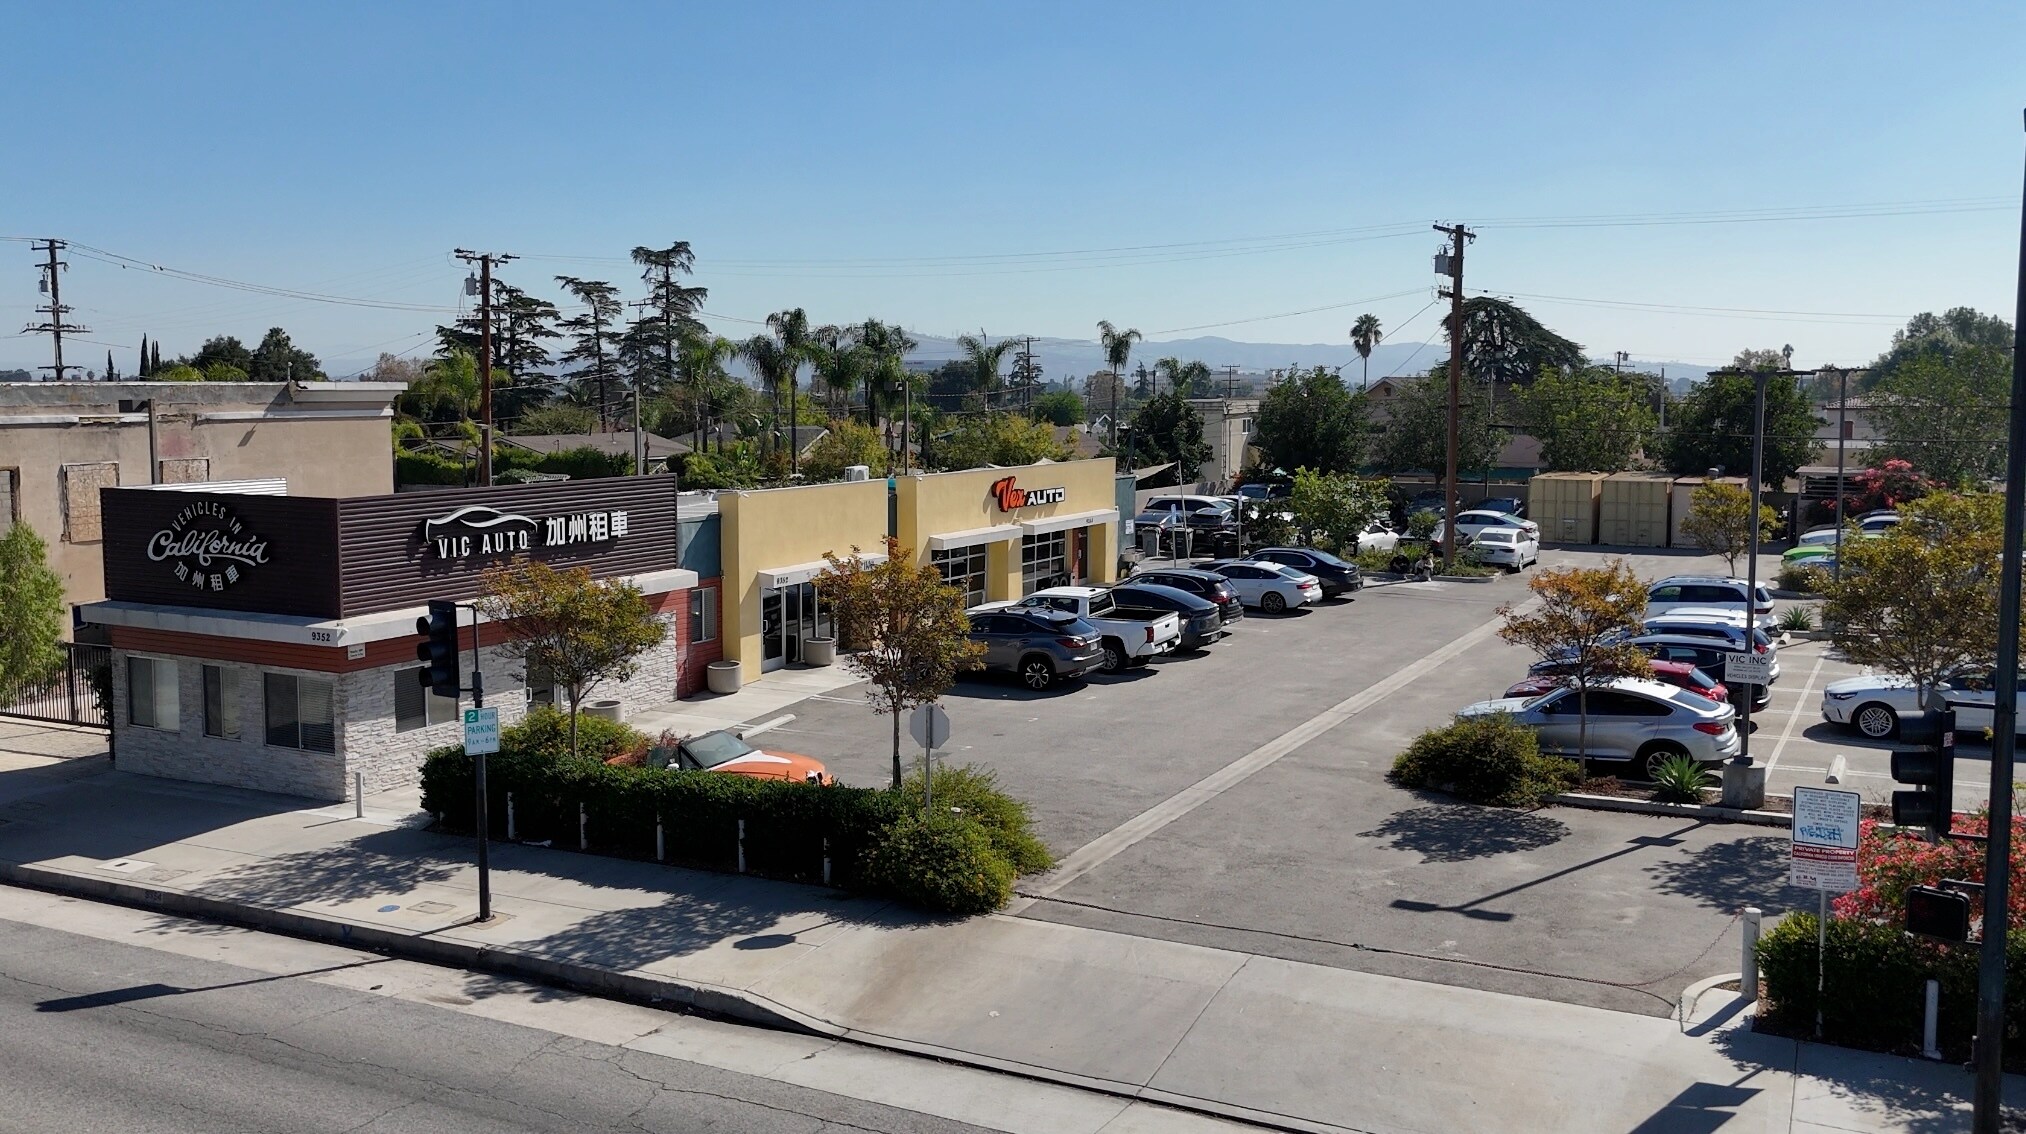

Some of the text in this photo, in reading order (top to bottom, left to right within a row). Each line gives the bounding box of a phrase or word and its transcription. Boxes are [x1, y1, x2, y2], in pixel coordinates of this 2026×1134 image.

[993, 476, 1065, 512] Vex AUTO
[172, 501, 242, 534] VEHICLES IN
[546, 511, 629, 547] 加州租車
[147, 529, 269, 567] California
[438, 530, 528, 559] VIC AUTO
[174, 561, 240, 592] 加州租車
[311, 631, 331, 642] 9352
[1729, 655, 1767, 664] VIC INC
[468, 711, 496, 721] 2 HOUR
[468, 724, 496, 735] PARKING
[1794, 845, 1820, 853] PRIVATE
